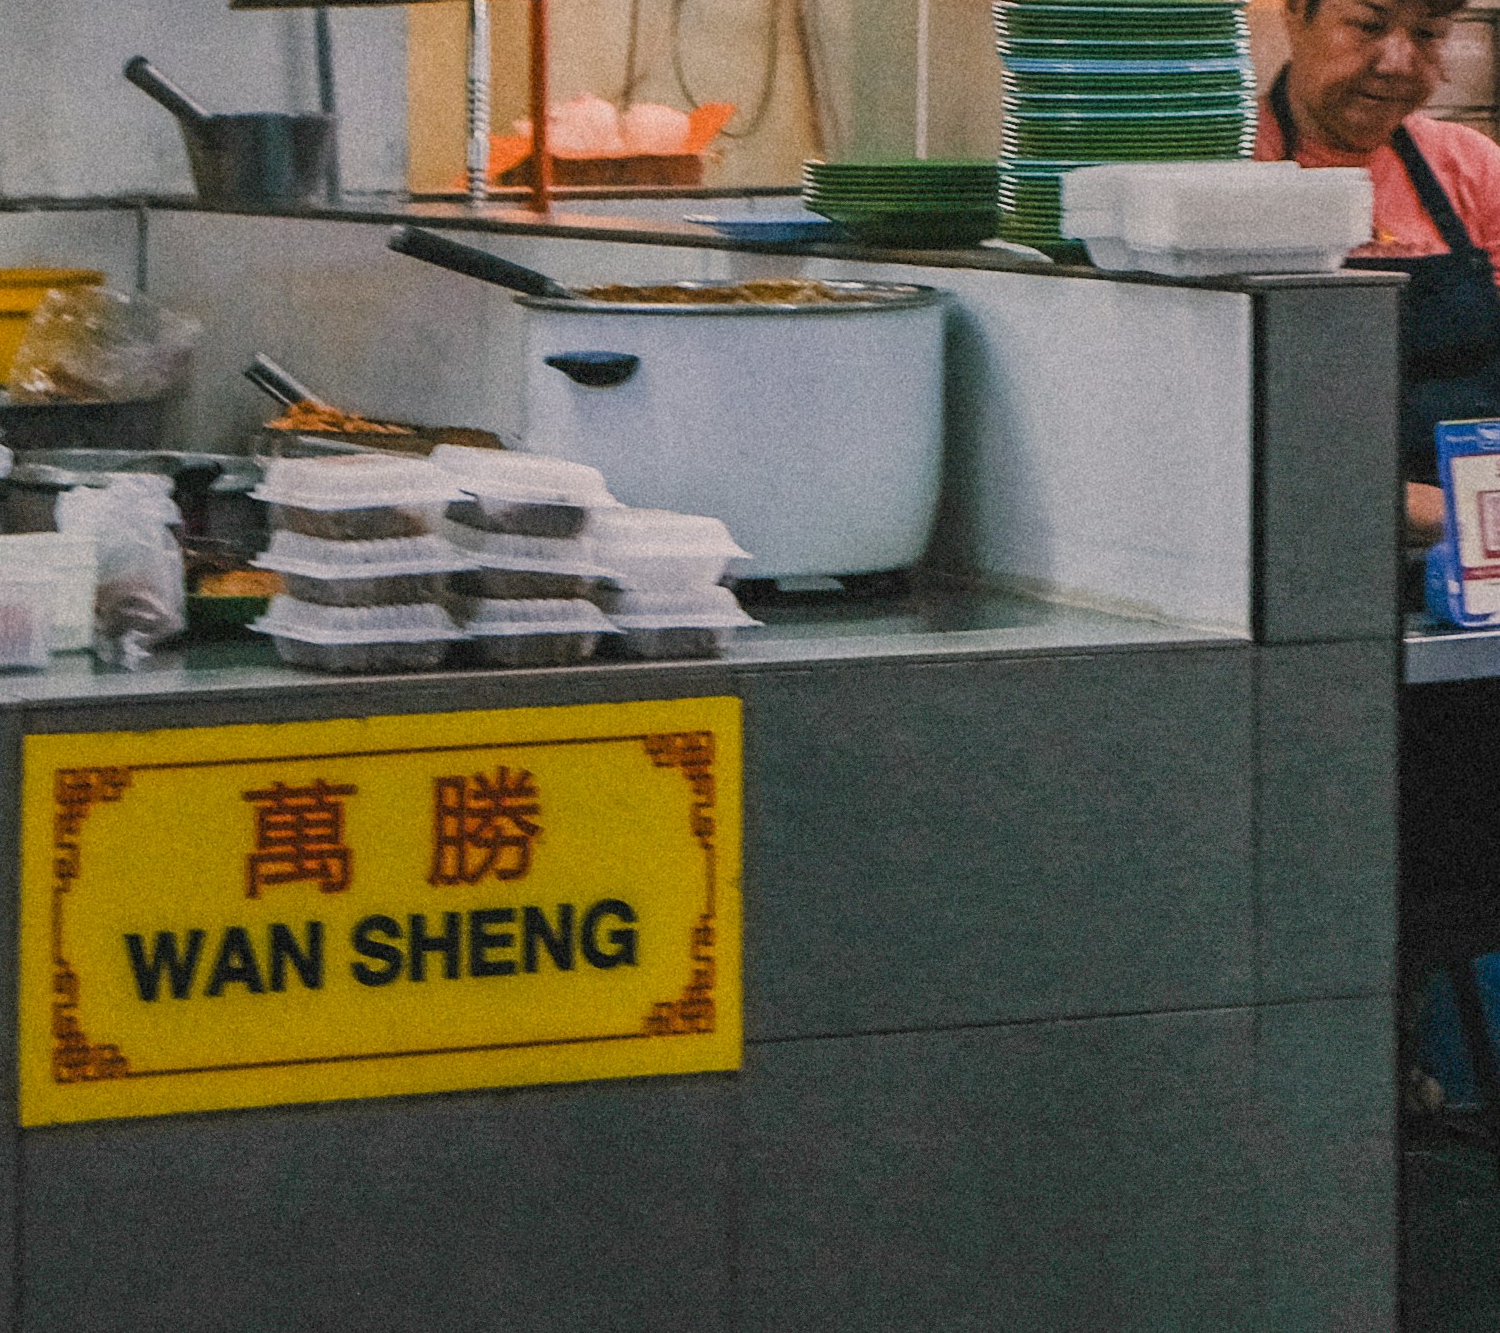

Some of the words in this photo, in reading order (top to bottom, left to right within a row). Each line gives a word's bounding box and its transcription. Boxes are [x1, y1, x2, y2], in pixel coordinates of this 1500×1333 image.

[241, 766, 545, 899] 萬勝
[124, 920, 326, 1002] WAN
[349, 898, 641, 987] SHENG
